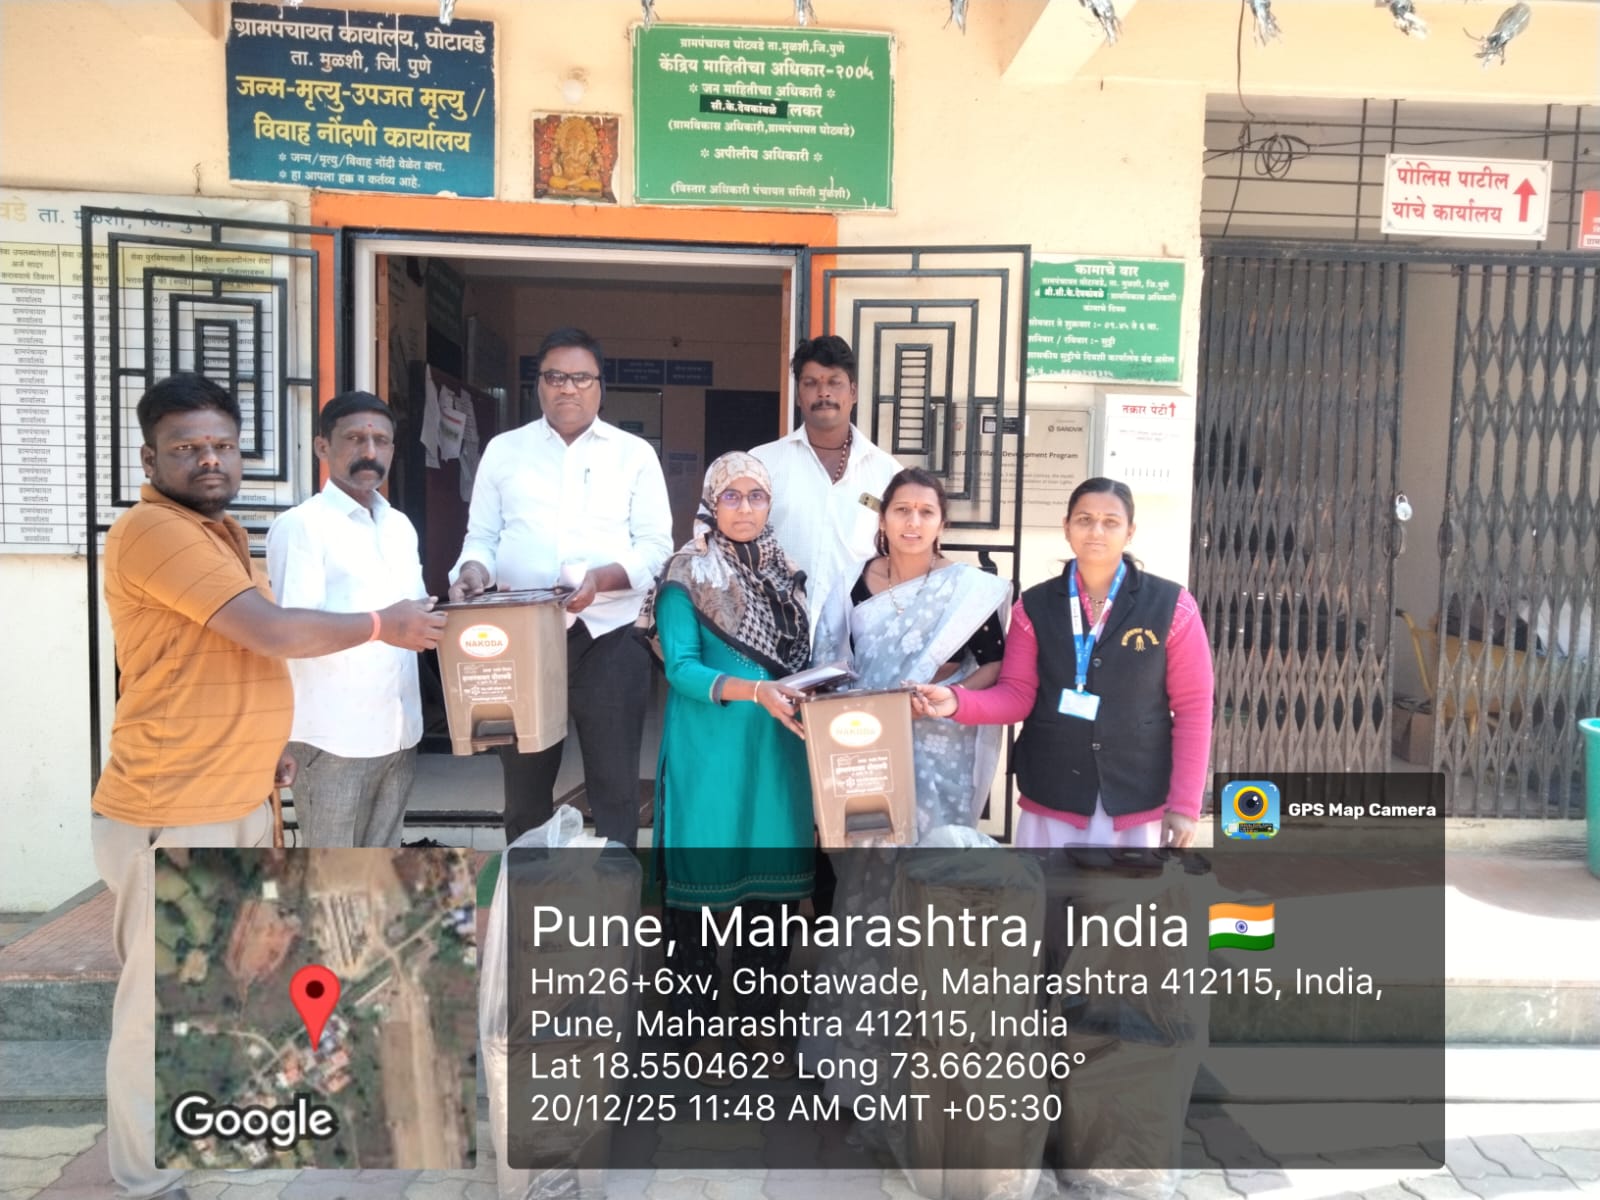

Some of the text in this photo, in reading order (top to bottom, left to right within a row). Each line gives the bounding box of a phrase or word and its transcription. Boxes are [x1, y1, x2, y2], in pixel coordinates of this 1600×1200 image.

[338, 22, 419, 51] कार्यालय,
[425, 27, 486, 54] घोटावडे
[290, 51, 313, 66] ता.
[320, 49, 369, 73] मुळशी,
[408, 54, 432, 78] पुणे
[702, 55, 765, 76] माहितीचा
[702, 81, 822, 99] जन माहितीचा अधिकारी
[420, 87, 468, 121] मृत्यु
[254, 112, 471, 152] विवाह नोंदणी कार्यालय
[714, 145, 809, 162] अपीलीय अधिकारी
[305, 171, 335, 183] आपला
[1397, 161, 1510, 190] पोलिस पाटील
[38, 208, 65, 224] ता.
[1392, 195, 1503, 223] यांचे कार्यालय
[1075, 261, 1116, 276] कामाचे
[465, 640, 503, 648] NAKODA
